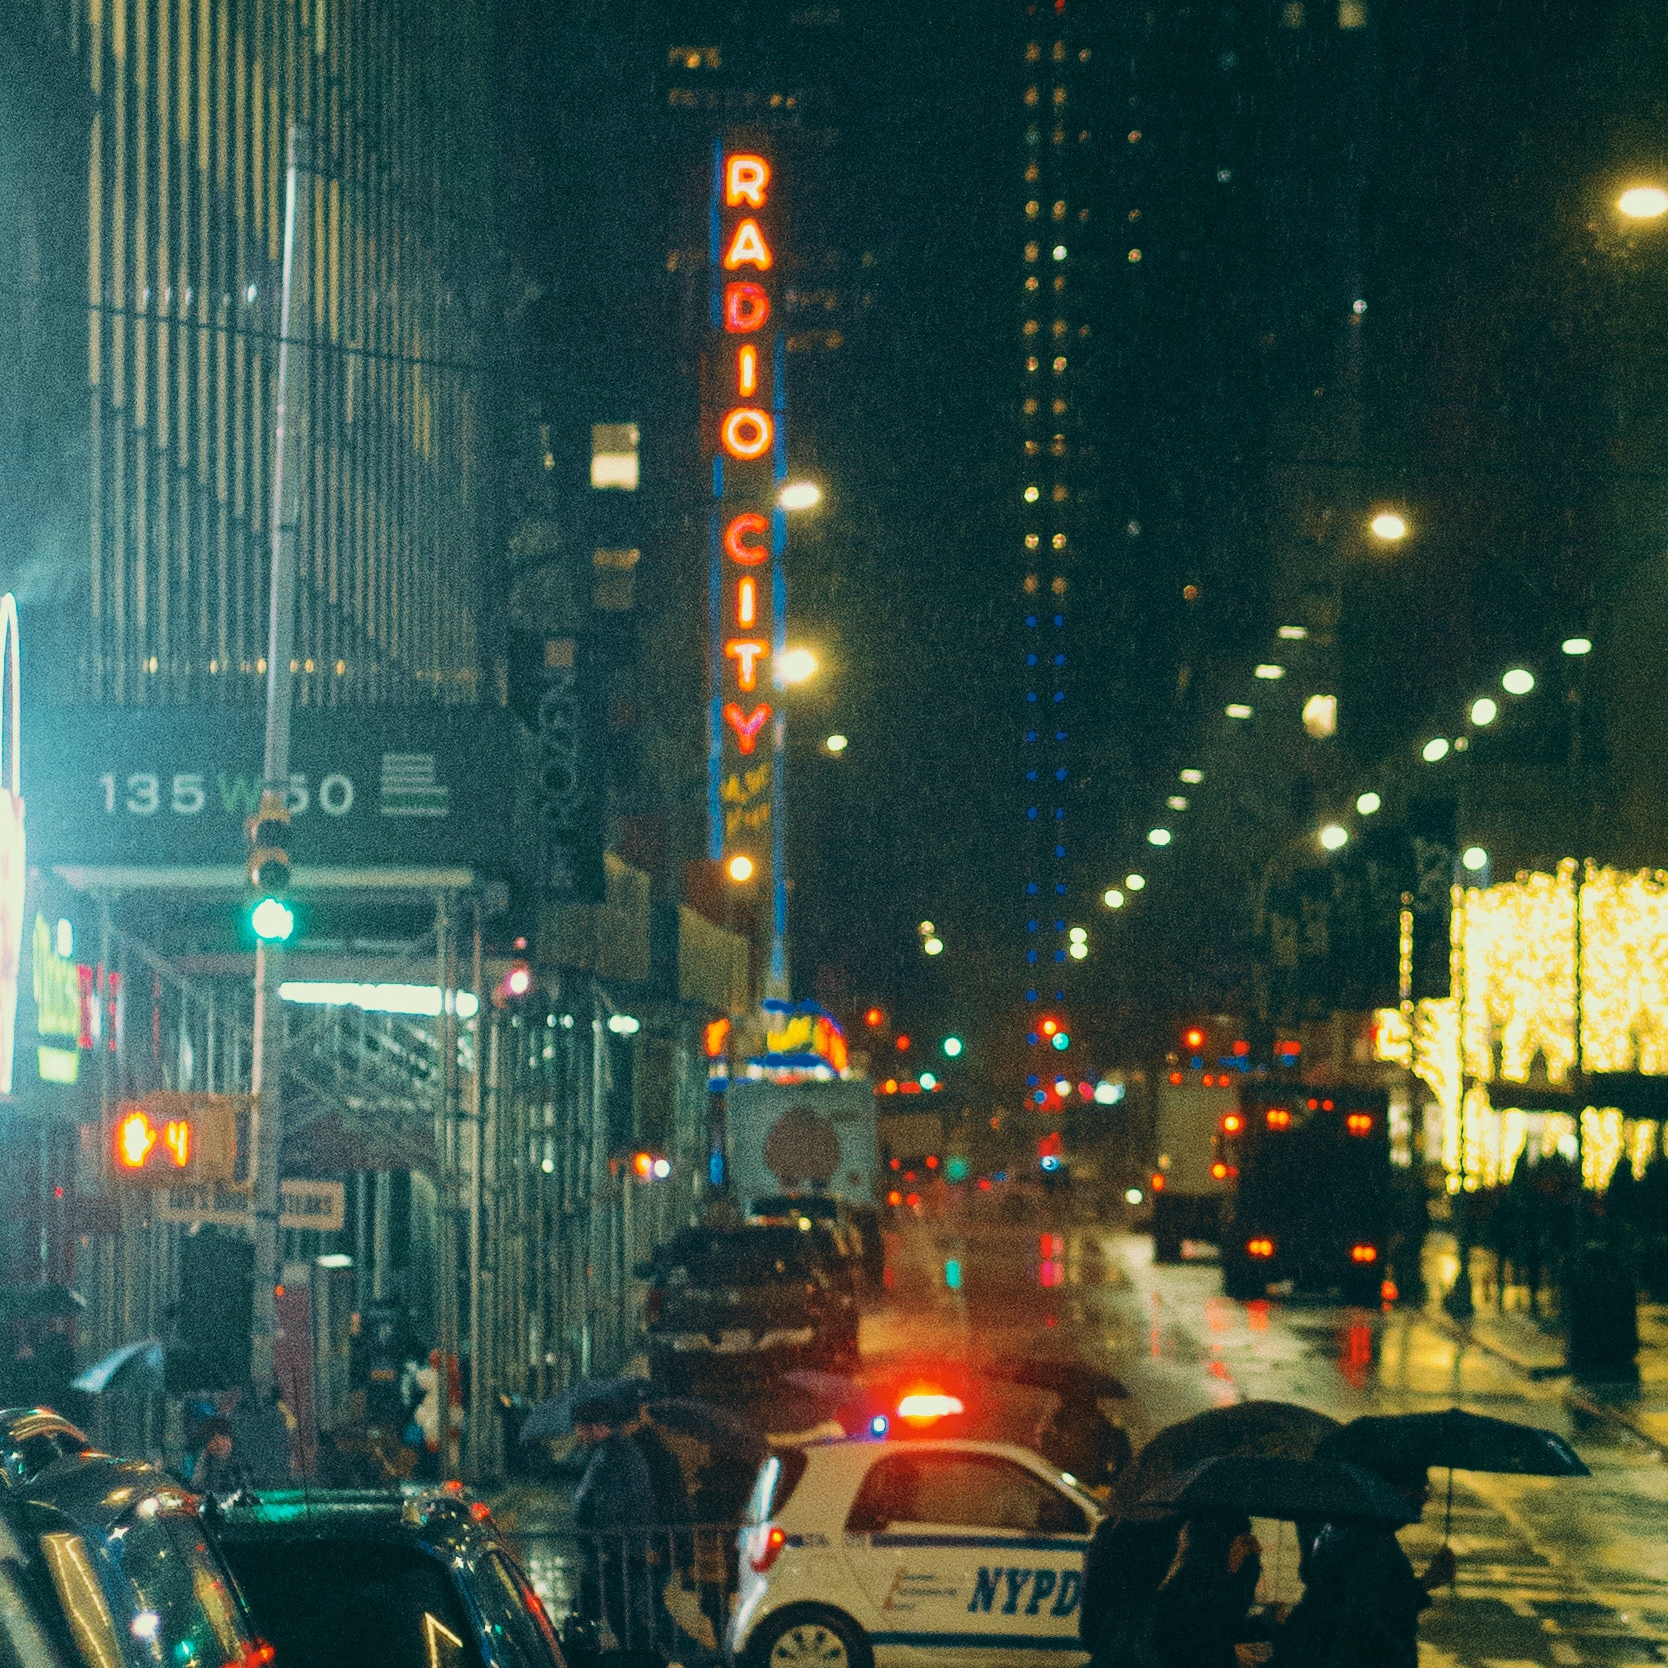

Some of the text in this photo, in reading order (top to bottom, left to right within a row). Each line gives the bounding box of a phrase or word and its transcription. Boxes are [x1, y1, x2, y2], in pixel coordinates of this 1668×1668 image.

[721, 152, 774, 461] RADIO
[722, 512, 772, 755] CITY
[100, 772, 205, 815] 135
[966, 1566, 1082, 1617] NYPD
